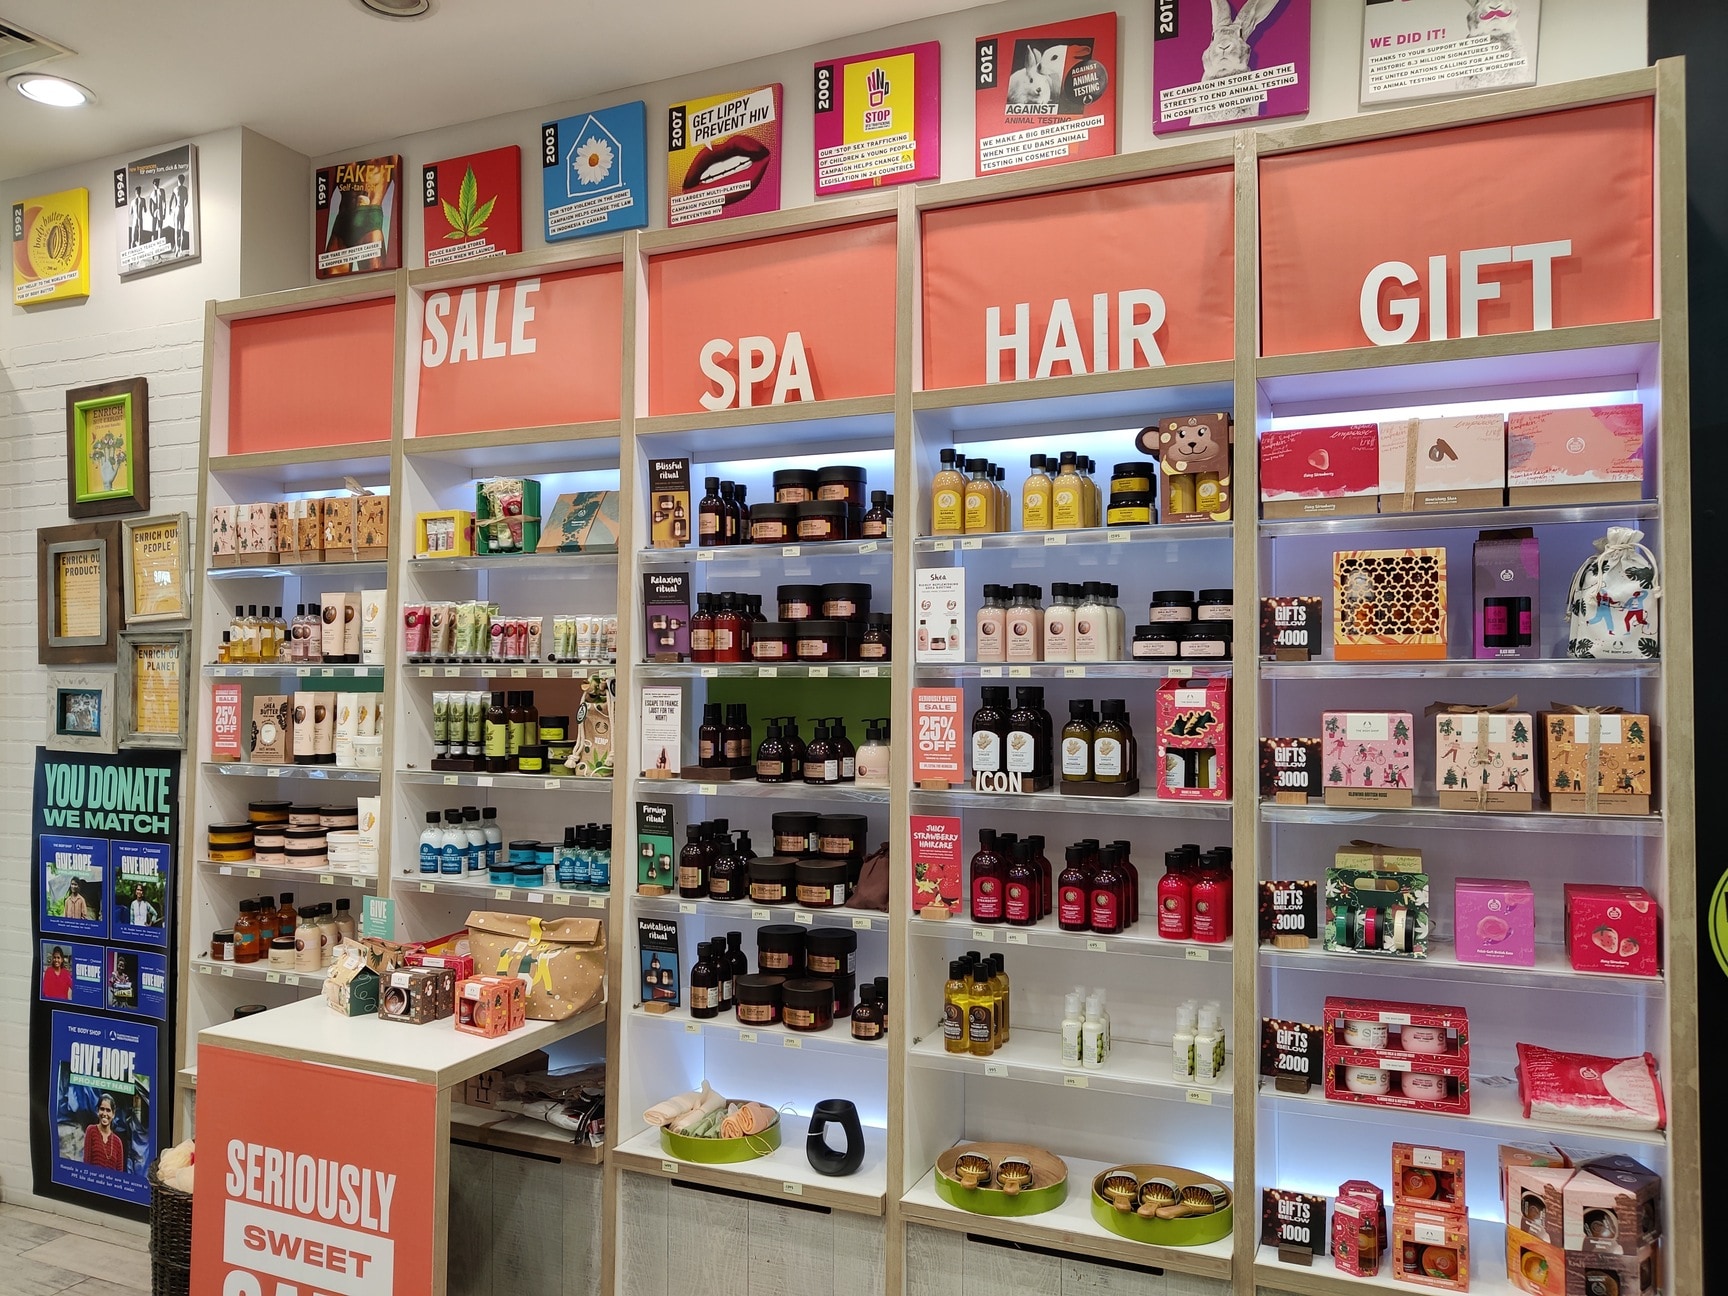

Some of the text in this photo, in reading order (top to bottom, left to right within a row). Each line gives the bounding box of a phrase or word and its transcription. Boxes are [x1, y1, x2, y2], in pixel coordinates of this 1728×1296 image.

[1370, 29, 1446, 48] WE DID IT!
[1371, 53, 1396, 63] THANKS
[1408, 48, 1425, 57] YOUR
[1428, 43, 1456, 53] SUPPORT
[1471, 37, 1488, 46] TOOK
[1377, 62, 1406, 72] HISTORIC
[1420, 54, 1446, 64] MILLION
[1448, 46, 1489, 59] SIGNATURES
[980, 45, 992, 83] 2012
[1072, 64, 1097, 74] AGAINST
[1073, 72, 1098, 86] ANIMAL
[1162, 66, 1292, 99] WE CAMPAIGN IN STORE & ON THE
[818, 69, 830, 110] 2009
[1073, 83, 1099, 97] TESTING
[1164, 76, 1295, 109] STREETS TO END ANIMAL TESTING
[693, 97, 749, 128] GET LIPPY
[865, 110, 890, 123] STOP
[1006, 105, 1055, 114] AGAINST
[1164, 94, 1265, 120] IN COSMETICS WORLDWIDE
[672, 111, 682, 147] 2007
[695, 106, 769, 141] PREVENT HIV
[982, 139, 993, 147] WE
[995, 135, 1016, 145] MAKE
[1025, 130, 1038, 139] BIG
[1040, 118, 1102, 136] BREAKTHROUGH
[546, 127, 555, 164] 2003
[866, 135, 907, 148] TRAFFICKING
[983, 133, 1086, 158] WHEN THE EU BANS ANIMAL
[830, 154, 860, 164] CHILDREN
[866, 148, 888, 157] YOUNG
[983, 158, 1013, 169] TESTING
[1025, 148, 1067, 162] COSMETICS
[336, 165, 395, 183] FAKE IT
[821, 156, 900, 176] CAMPAIGN HELPS CHANGE
[821, 173, 859, 186] LEGISLATION
[878, 163, 914, 175] COUNTRIES
[117, 173, 125, 203] 1994
[318, 177, 326, 205] 1997
[426, 171, 435, 203] 1998
[42, 212, 64, 226] butter
[1360, 239, 1572, 346] GIFT
[422, 277, 541, 368] SALE
[986, 288, 1166, 384] HAIR
[699, 332, 815, 411] SPA
[93, 406, 123, 419] ENRICH
[656, 462, 682, 470] Blissful
[660, 471, 679, 479] ritual
[134, 530, 161, 543] ENRICH
[143, 541, 171, 553] PEOPLE
[62, 555, 88, 565] ENRICH
[650, 576, 682, 586] Relaxing
[656, 584, 678, 593] ritual
[1275, 606, 1306, 621] GIFTS
[139, 650, 165, 659] ENRICH
[147, 662, 175, 670] PLANET
[216, 706, 236, 725] 25%
[216, 725, 237, 733] OFF
[919, 716, 956, 740] 25%
[919, 740, 956, 751] OFF
[1275, 748, 1306, 763] GIFTS
[45, 763, 171, 813] YOU DONATE
[976, 771, 1022, 793] ICON
[643, 805, 666, 816] Firming
[646, 814, 664, 823] ritual
[43, 808, 169, 834] WE MATCH
[926, 824, 945, 832] JUICY
[914, 832, 958, 841] STRAWBERRY
[920, 841, 953, 849] HAIRCARE
[56, 852, 91, 871] GIVE HOPE
[122, 856, 159, 876] GIVE HOPE
[1274, 890, 1303, 905] GIFTS
[370, 900, 387, 919] GIVE
[640, 922, 676, 934] Revitalising
[649, 931, 668, 940] ritual
[76, 963, 100, 978] GIVE HOPE
[142, 972, 164, 989] GIVE HOPE
[1277, 1029, 1308, 1048] GIFTS
[1277, 1044, 1307, 1053] BELOW
[70, 1042, 136, 1083] GIVE HOPE
[73, 1076, 131, 1091] PROJECT NARI
[226, 1139, 396, 1233] SERIOUSLY
[1278, 1199, 1310, 1218] GIFTS
[1278, 1214, 1310, 1224] BELOW
[244, 1225, 372, 1278] SWEET
